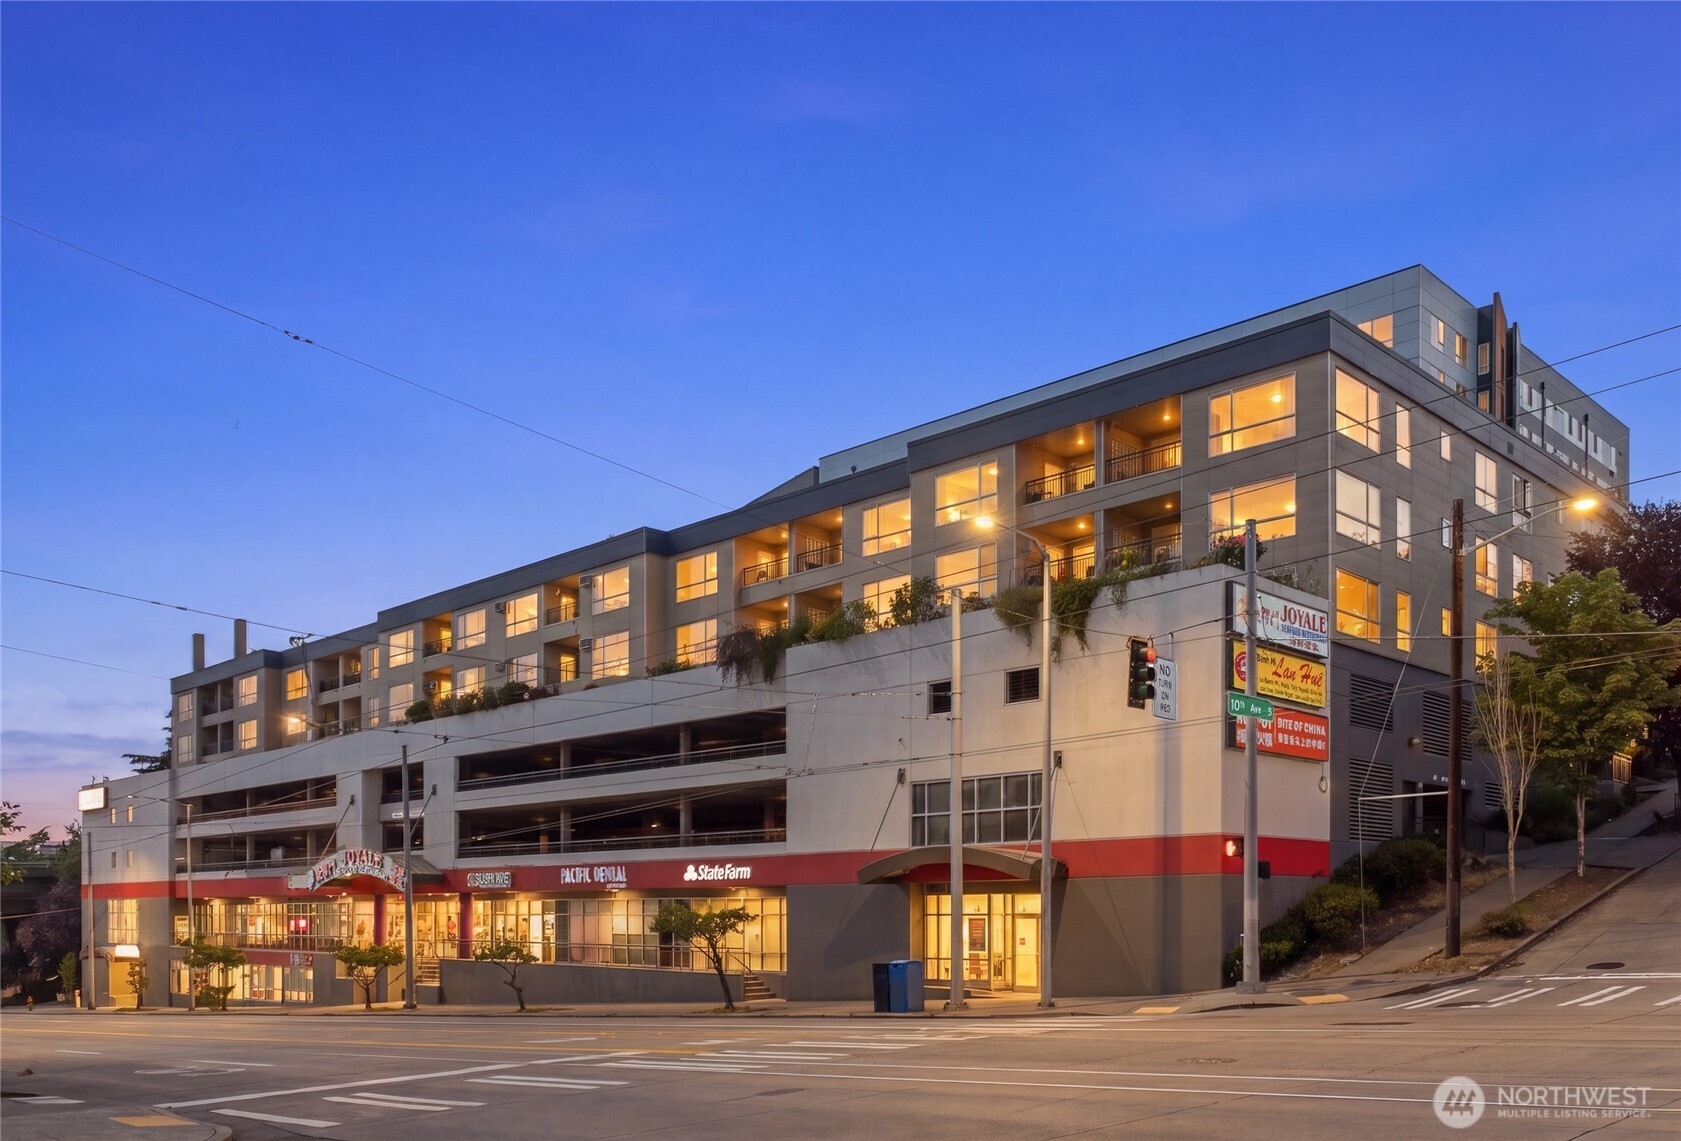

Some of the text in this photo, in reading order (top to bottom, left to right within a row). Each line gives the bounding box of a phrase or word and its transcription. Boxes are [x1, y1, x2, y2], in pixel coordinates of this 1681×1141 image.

[1280, 604, 1327, 634] JOYALE
[1159, 664, 1171, 677] NO
[1272, 656, 1297, 681] Lan
[1158, 678, 1172, 690] TURN
[1161, 691, 1170, 701] ON
[1250, 704, 1262, 714] Ave
[1267, 706, 1273, 717] S
[1277, 717, 1326, 736] BITE OF CHINA
[560, 865, 627, 884] PACIFIC DENTAL
